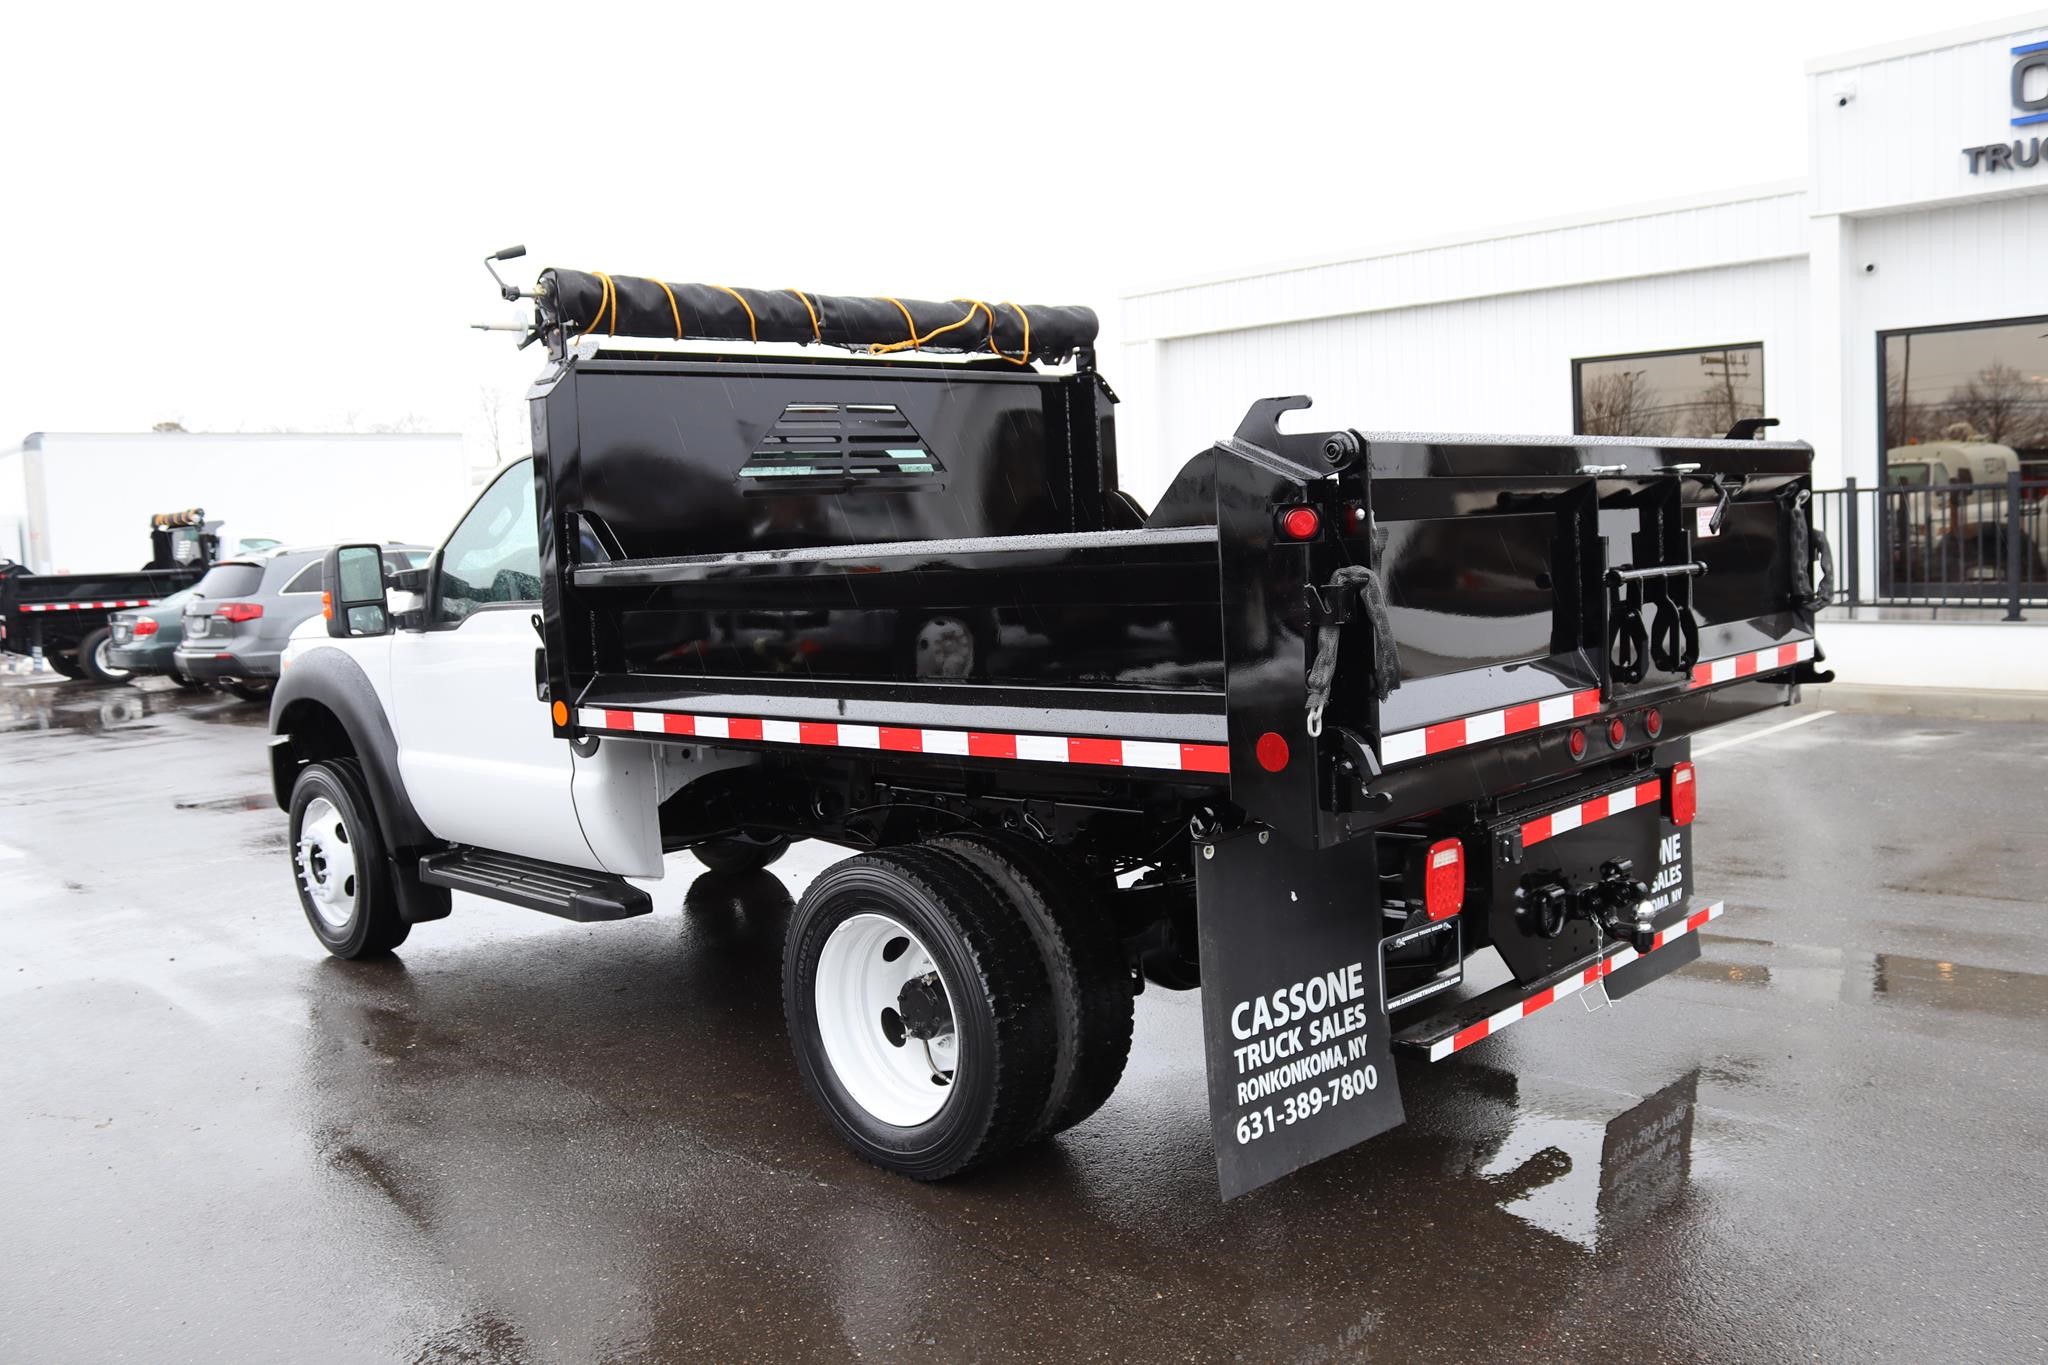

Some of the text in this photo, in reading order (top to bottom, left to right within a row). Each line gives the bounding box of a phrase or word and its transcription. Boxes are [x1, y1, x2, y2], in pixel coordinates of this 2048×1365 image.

[1231, 962, 1365, 1041] CASSONE
[1233, 1003, 1367, 1074] TRUCK SALES
[1236, 1064, 1378, 1145] 631-389-7800
[1237, 1034, 1368, 1106] RONKONKOMA, NY
